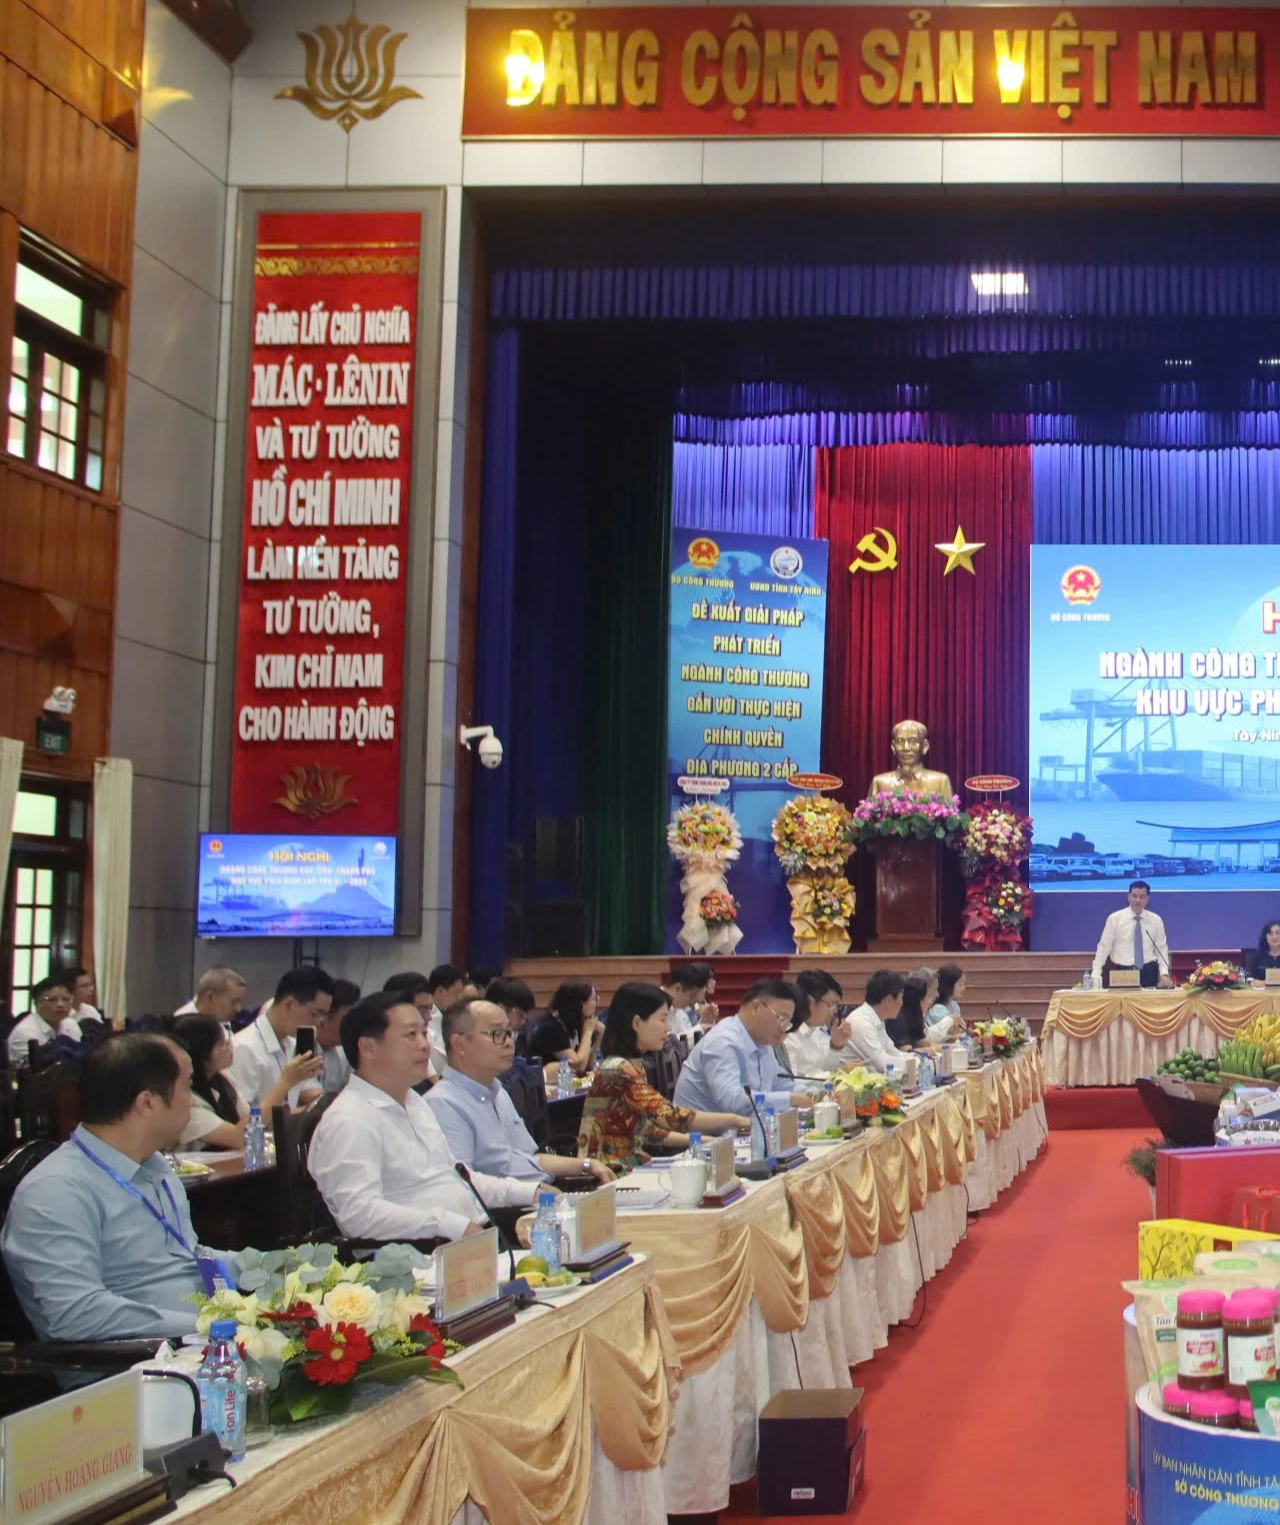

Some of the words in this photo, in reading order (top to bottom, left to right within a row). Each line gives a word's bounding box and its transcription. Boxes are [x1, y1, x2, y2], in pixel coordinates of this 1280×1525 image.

[505, 11, 660, 107] ĐẢNG
[681, 12, 839, 121] CỘNG
[859, 10, 974, 105] SẢN
[993, 11, 1117, 119] VIỆT
[1138, 31, 1257, 104] NAM
[255, 303, 299, 345] ĐẢNG
[300, 301, 329, 345] LẤY
[330, 303, 361, 345] CHỦ
[364, 305, 410, 344] NGHĨA
[256, 417, 284, 459] VÀ
[289, 421, 321, 459] TƯ
[326, 415, 399, 459] TƯỞNG
[251, 464, 288, 527] HỒ
[289, 470, 331, 526] CHÍ
[334, 478, 400, 526] MINH
[247, 538, 294, 580] LÀM
[297, 534, 340, 580] NỀN
[343, 537, 399, 580] TẢNG
[263, 595, 295, 634] TƯ
[691, 598, 708, 619] ĐỀ
[711, 600, 741, 622] XUẤT
[745, 604, 769, 624] GIẢI
[773, 606, 804, 627] PHÁP
[713, 634, 743, 653] PHÁT
[747, 633, 781, 655] TRIỂN
[255, 654, 296, 688] KIM
[297, 645, 334, 688] CHỈ
[334, 654, 383, 687] NAM
[681, 662, 722, 683] NGÀNH
[726, 664, 759, 685] CÔNG
[763, 668, 809, 688] THƯƠNG
[1099, 647, 1183, 678] NGÀNH
[1190, 647, 1256, 678] CÔNG
[687, 692, 712, 713] GẮN
[715, 693, 736, 715] VỚI
[740, 699, 770, 719] THỰC
[773, 699, 801, 721] HIỆN
[1136, 689, 1187, 716] KHU
[1194, 687, 1242, 721] VỰC
[239, 705, 282, 741] CHO
[284, 698, 336, 740] HÀNH
[339, 697, 395, 747] ĐỘNG
[704, 726, 741, 746] CHÍNH
[745, 726, 783, 748] QUYỀN
[1232, 729, 1257, 744] Tây
[686, 759, 708, 775] ĐỊA
[711, 759, 760, 778] PHƯƠNG
[763, 763, 773, 778] 2
[774, 757, 798, 778] CẤP
[1179, 1462, 1206, 1480] NHÂN
[1209, 1468, 1232, 1484] DÂN
[1236, 1470, 1261, 1488] TỈNH
[1175, 1478, 1187, 1494] SỞ
[1190, 1484, 1222, 1503] CÔNG
[1225, 1492, 1280, 1511] THƯƠNG
